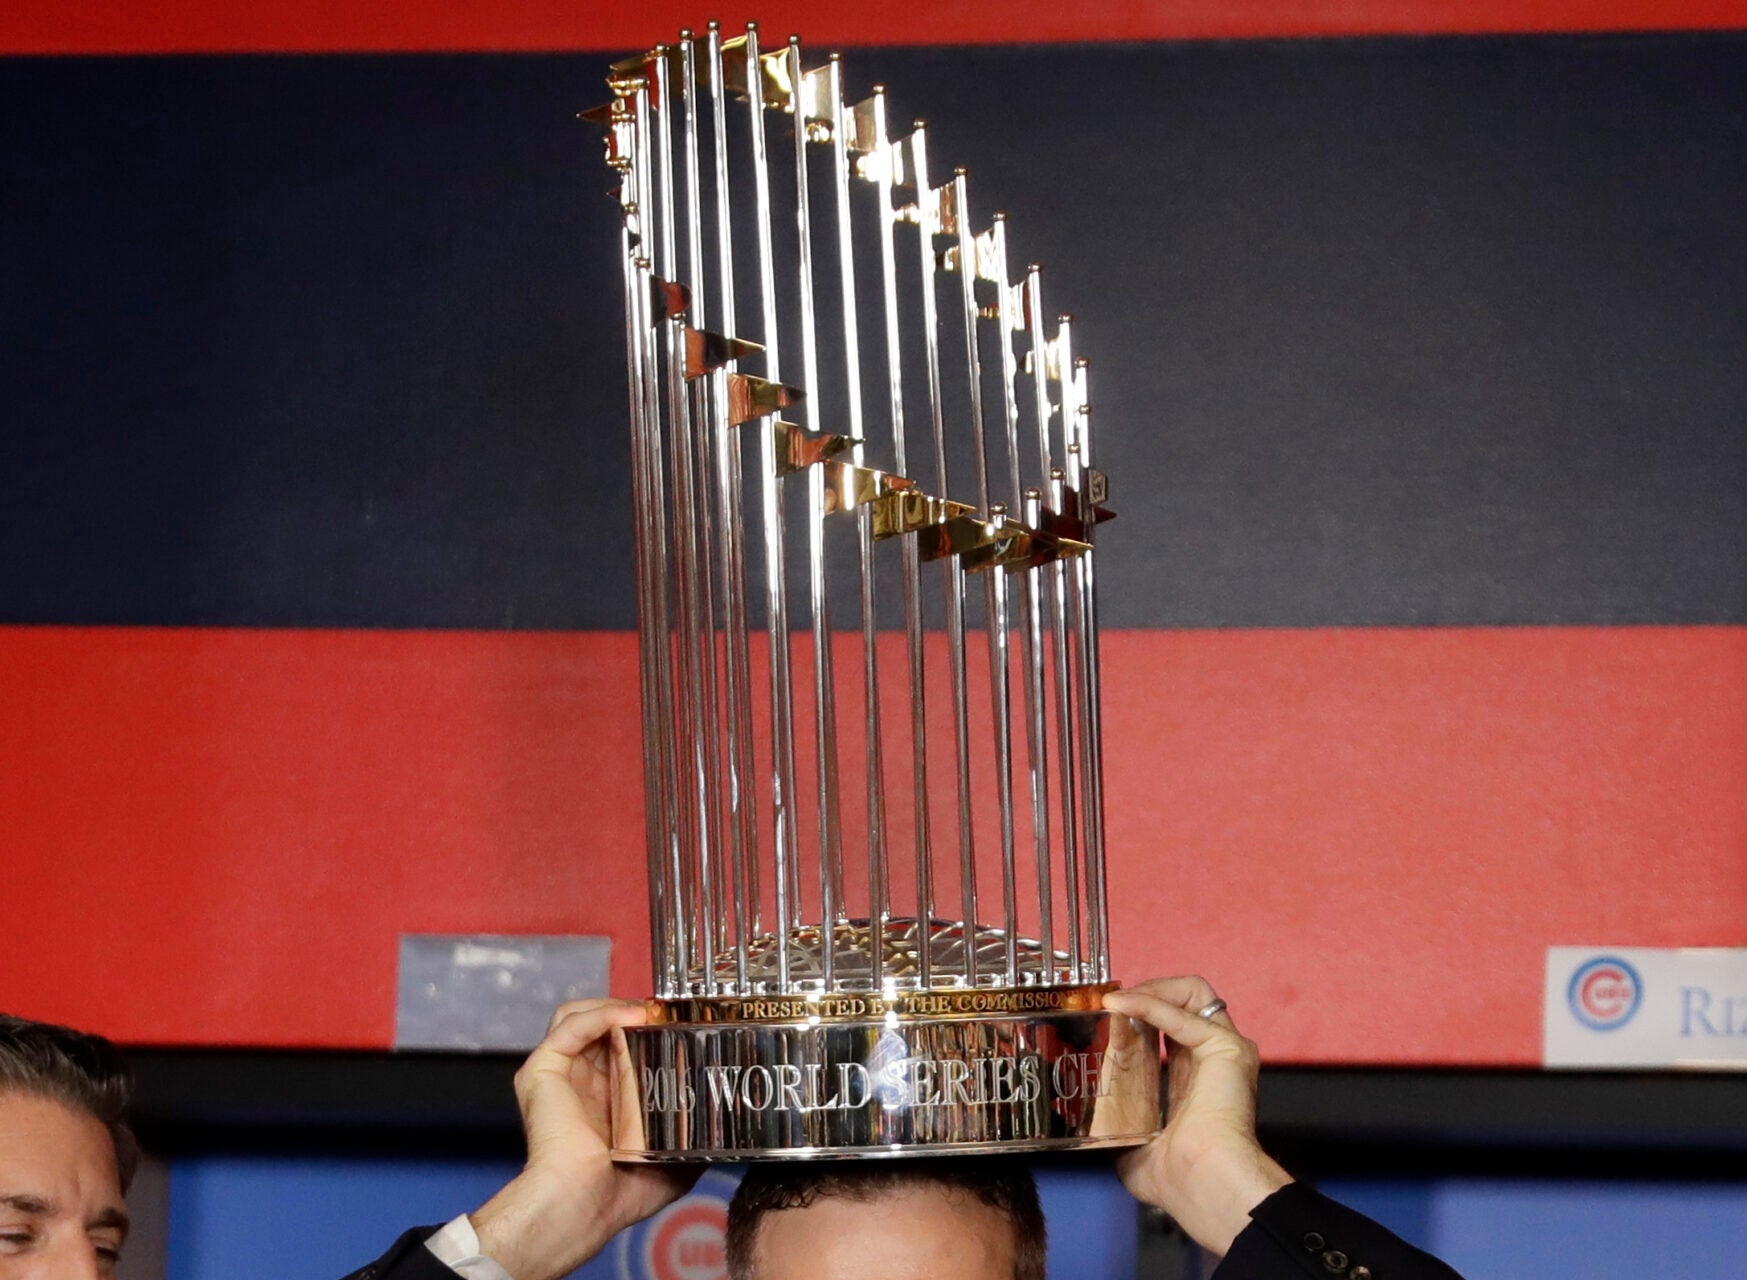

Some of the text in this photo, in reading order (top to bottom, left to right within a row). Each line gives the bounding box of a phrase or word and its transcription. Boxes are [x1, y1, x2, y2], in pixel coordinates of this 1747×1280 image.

[742, 998, 864, 1019] PRESENTED
[907, 995, 952, 1014] THE
[642, 1066, 696, 1113] 2016
[704, 1061, 873, 1113] WORLD
[881, 1053, 1042, 1109] SERIES
